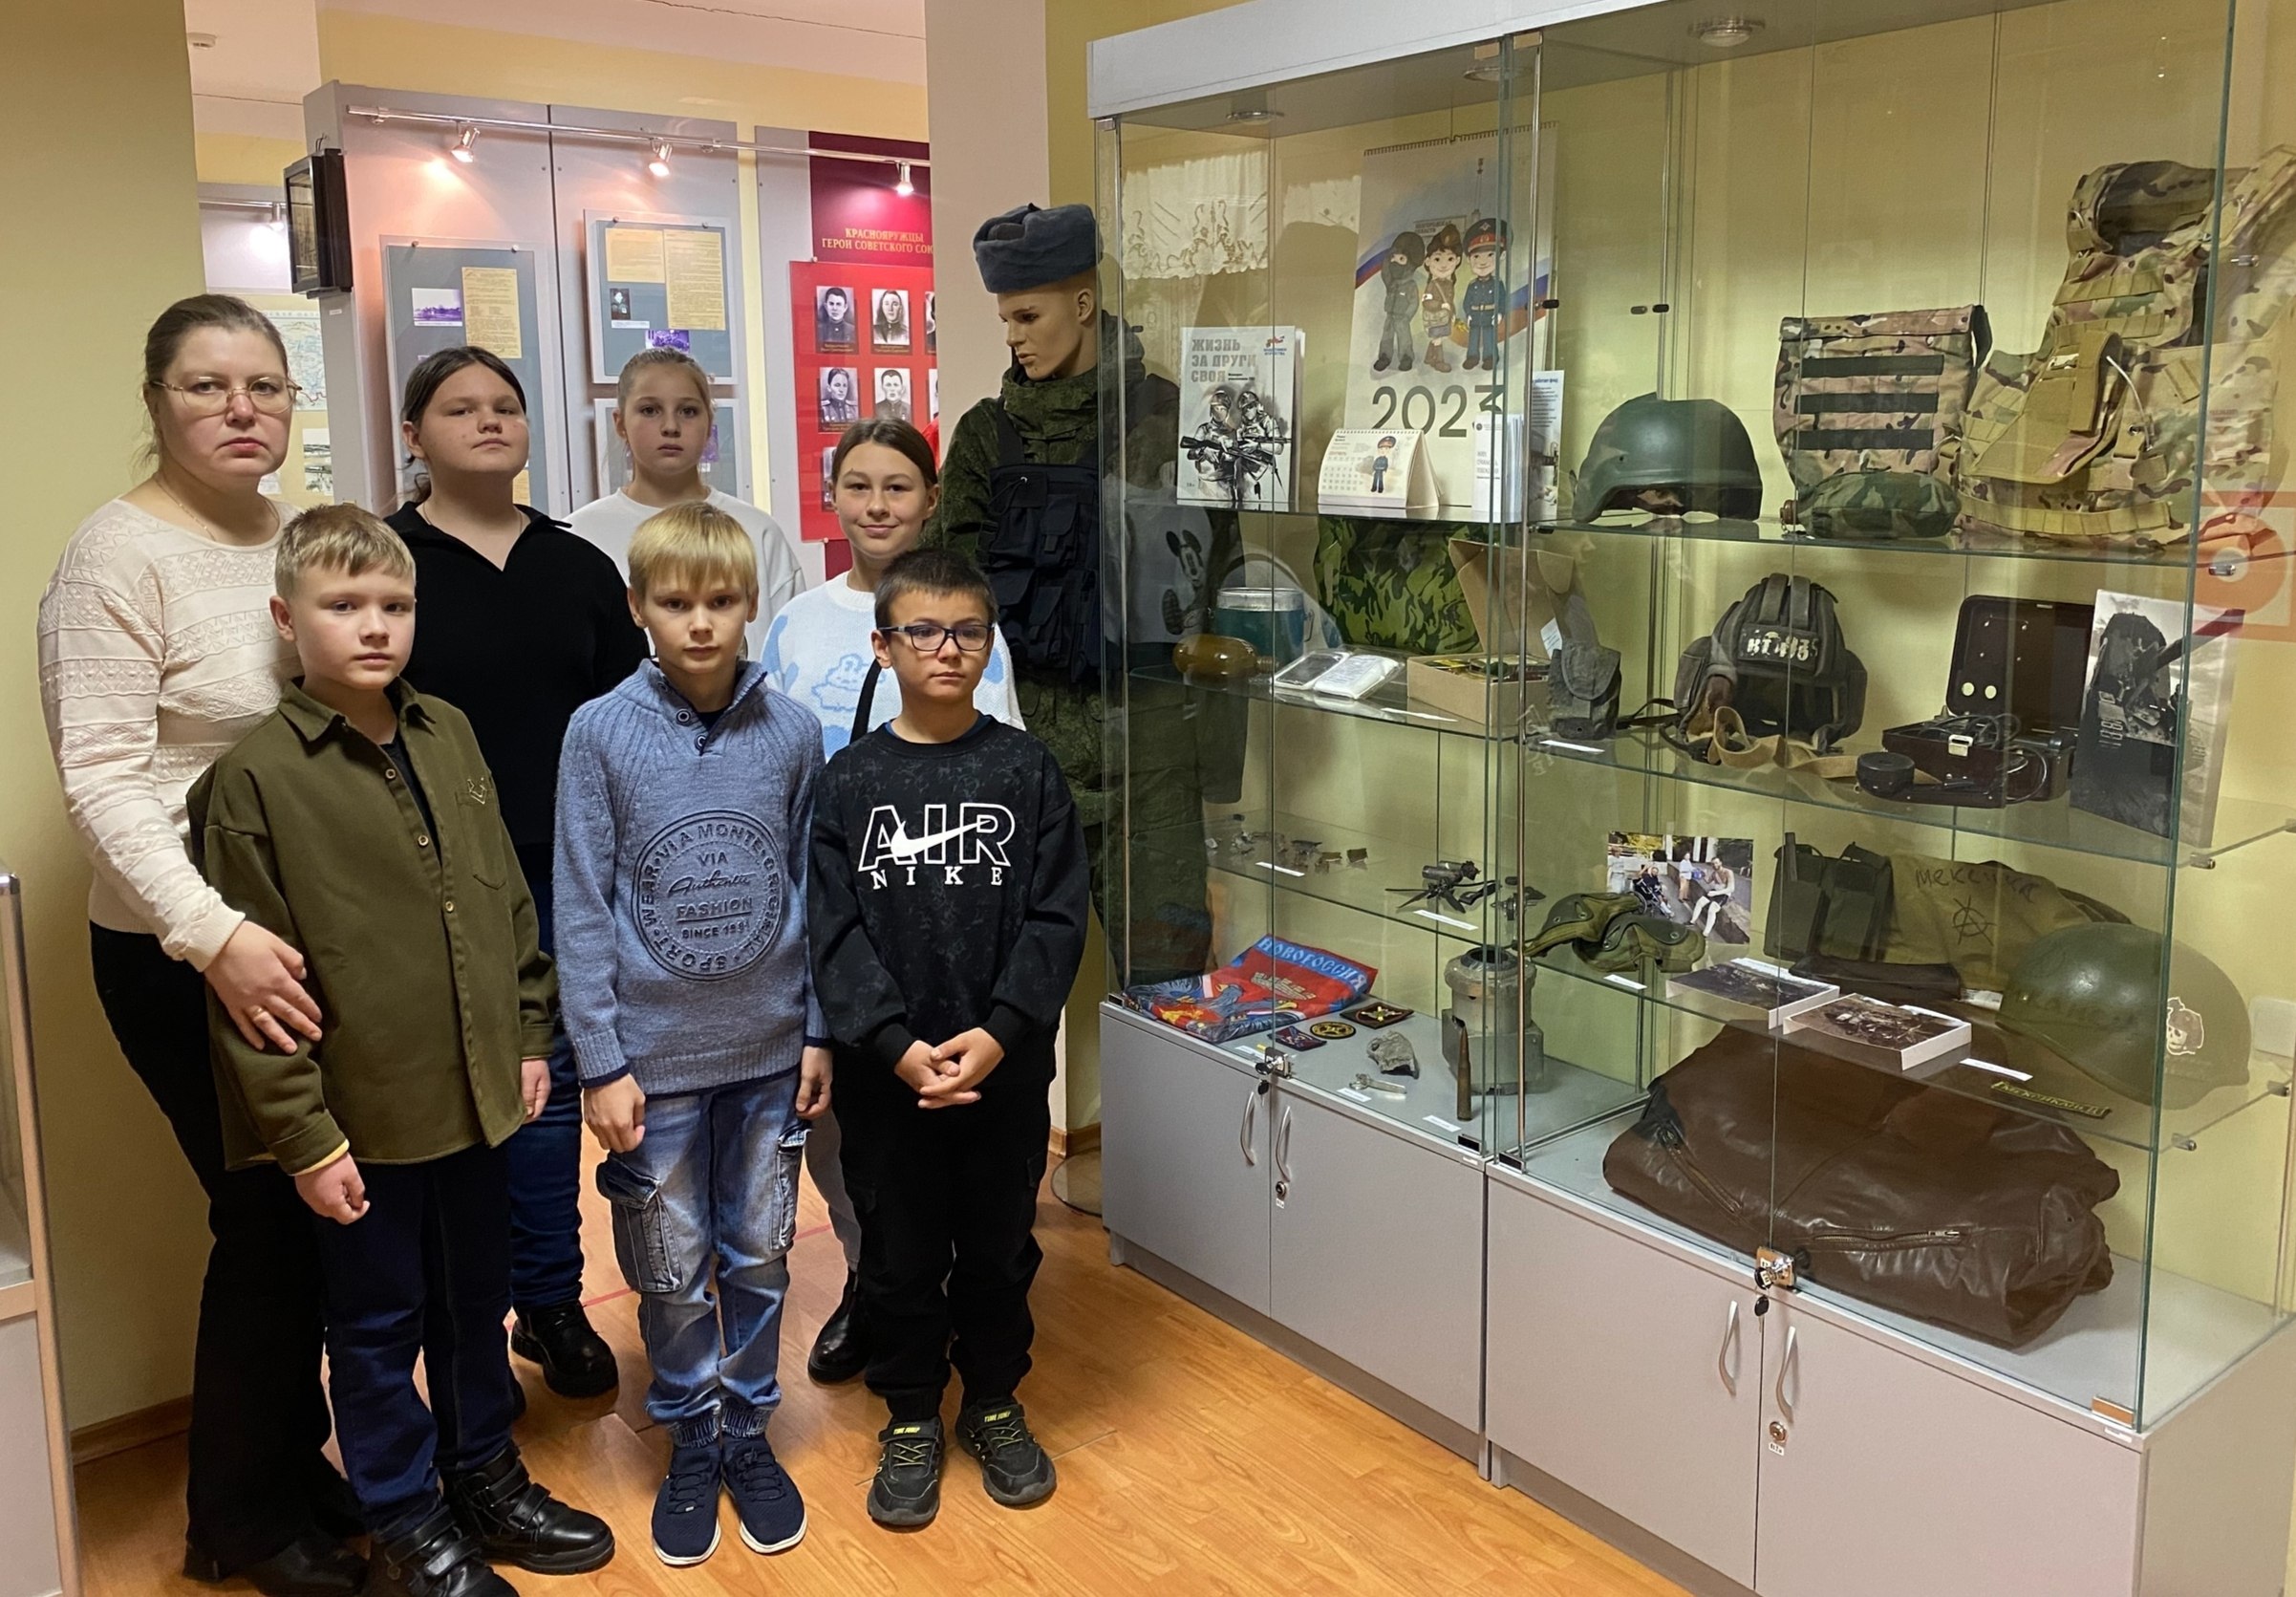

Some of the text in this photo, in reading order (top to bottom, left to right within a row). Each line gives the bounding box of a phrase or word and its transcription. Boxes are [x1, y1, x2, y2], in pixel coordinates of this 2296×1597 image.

[845, 227, 924, 243] КРАСНОЯРУЖЦЫ
[822, 238, 852, 249] ГЕРОИ
[854, 240, 913, 253] СОВЕТСКОГО
[1191, 339, 1240, 352] ЖИЗНЬ
[1191, 355, 1256, 368] ЗА ДРУГИ
[1191, 370, 1226, 383] СВОЯ
[858, 803, 1015, 872] AIR
[697, 852, 728, 867] VIA
[870, 866, 1002, 890] NIKE
[676, 896, 752, 918] FASHION
[682, 925, 719, 939] SINCE
[1257, 937, 1368, 992] НОВОРОССИЯ
